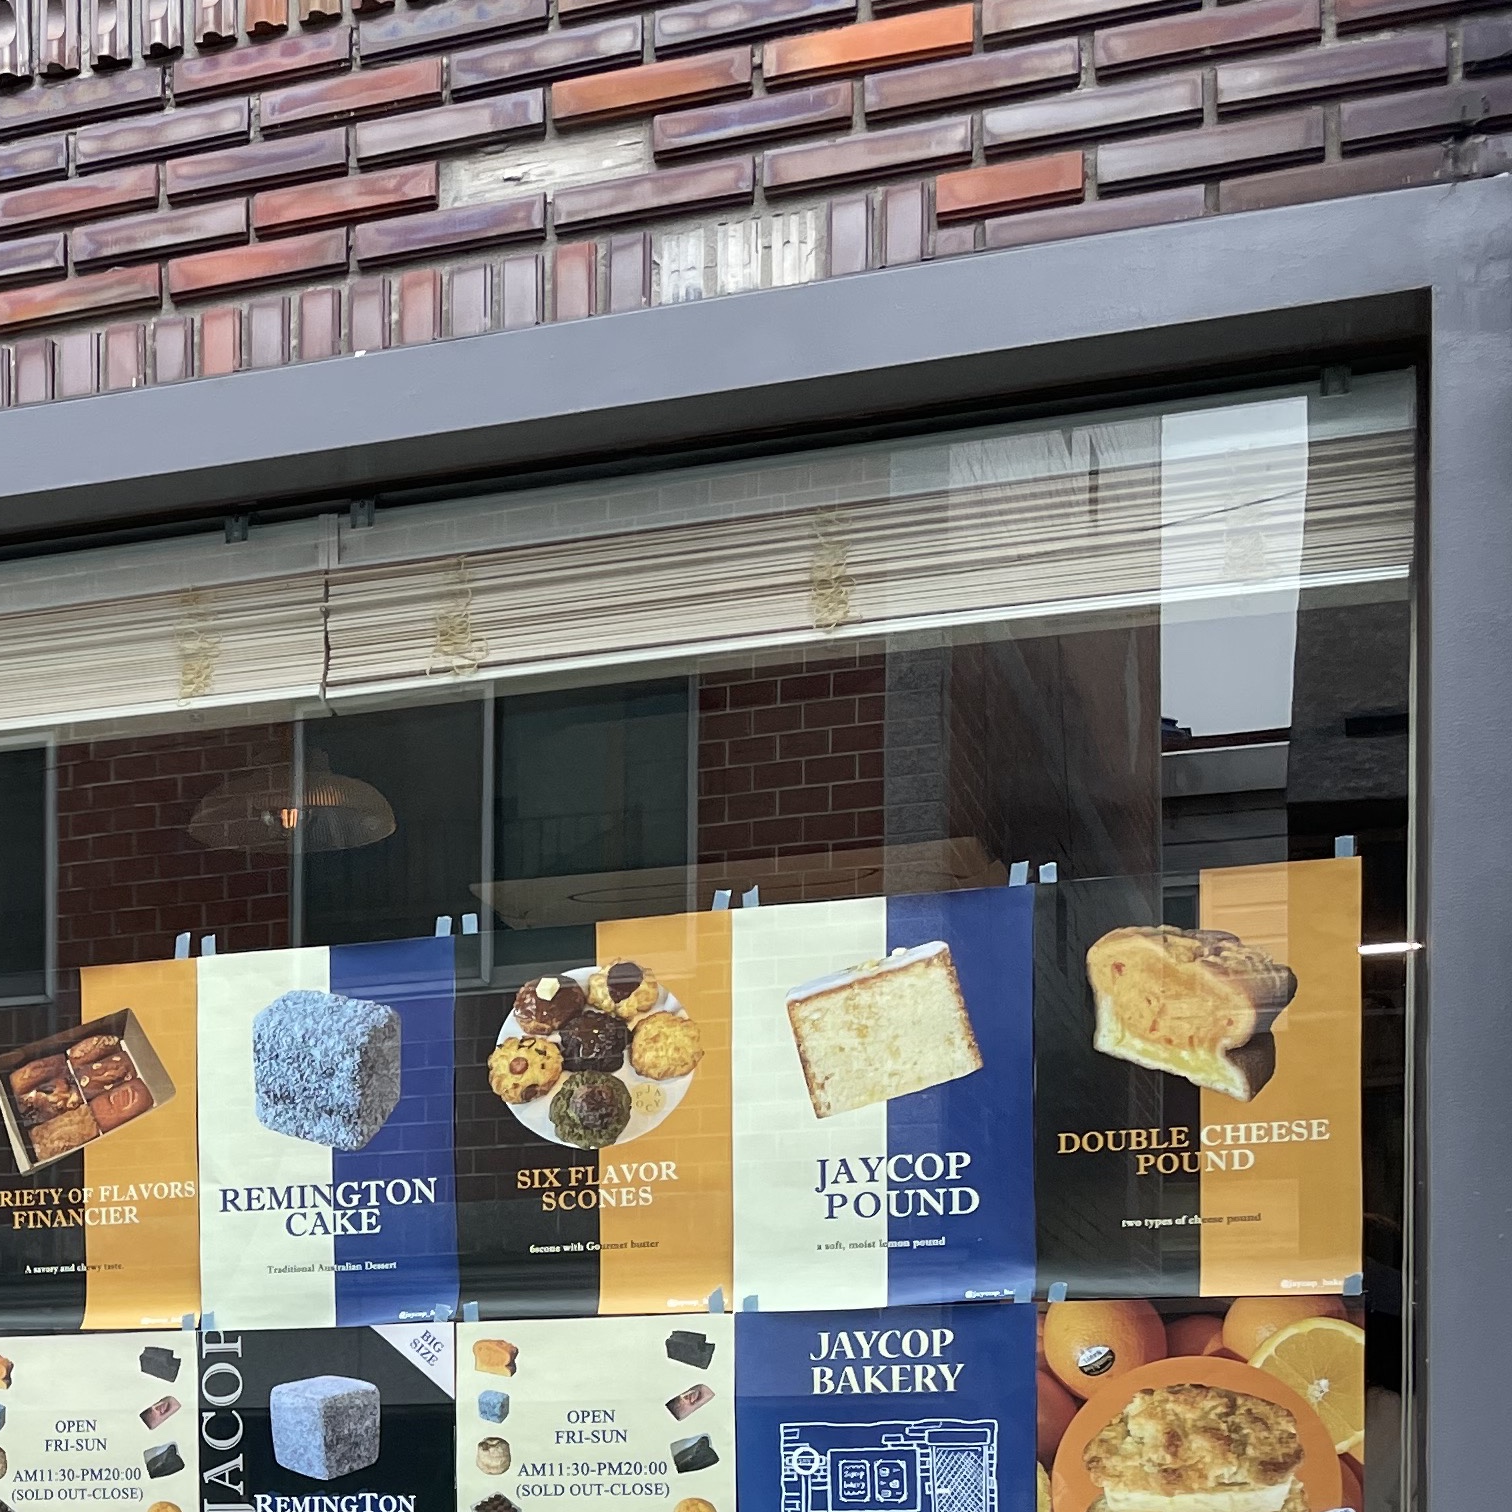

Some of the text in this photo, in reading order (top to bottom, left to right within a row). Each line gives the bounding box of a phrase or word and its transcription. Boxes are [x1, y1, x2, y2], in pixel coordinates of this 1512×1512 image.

[1057, 1119, 1330, 1155] DOUBLE CHEESE
[815, 1152, 971, 1193] JAYCOP
[1136, 1149, 1255, 1175] POUND
[517, 1161, 678, 1189] SIX FLAVOR
[68, 1187, 94, 1204] OF
[99, 1181, 195, 1202] FLAVORS
[219, 1177, 437, 1213] REMINGTON
[542, 1186, 653, 1212] SCONES
[824, 1187, 980, 1219] POUND
[13, 1206, 139, 1229] FINANCIER
[286, 1208, 381, 1237] CAKE
[1122, 1218, 1142, 1228] two
[1144, 1216, 1173, 1229] types
[1175, 1215, 1187, 1226] of
[563, 1242, 584, 1252] with
[60, 1264, 75, 1272] and
[267, 1264, 315, 1274] Traditional
[318, 1262, 362, 1272] Australian
[410, 1338, 438, 1366] SIZE
[420, 1330, 444, 1353] BIG
[809, 1328, 955, 1361] JAYCOP
[811, 1363, 964, 1395] BAKERY
[55, 1420, 97, 1433] OPEN
[567, 1410, 615, 1424] OPEN
[45, 1438, 107, 1452] FRI-SUN
[555, 1430, 628, 1444] FRI-SUN
[12, 1467, 142, 1483] AM11:30-PM20:00
[517, 1461, 668, 1477] AM11:30-PM20:00
[11, 1487, 144, 1502] (SOLD OUT-CLOSE)
[516, 1482, 671, 1499] (SOLD OUT-CLOSE)
